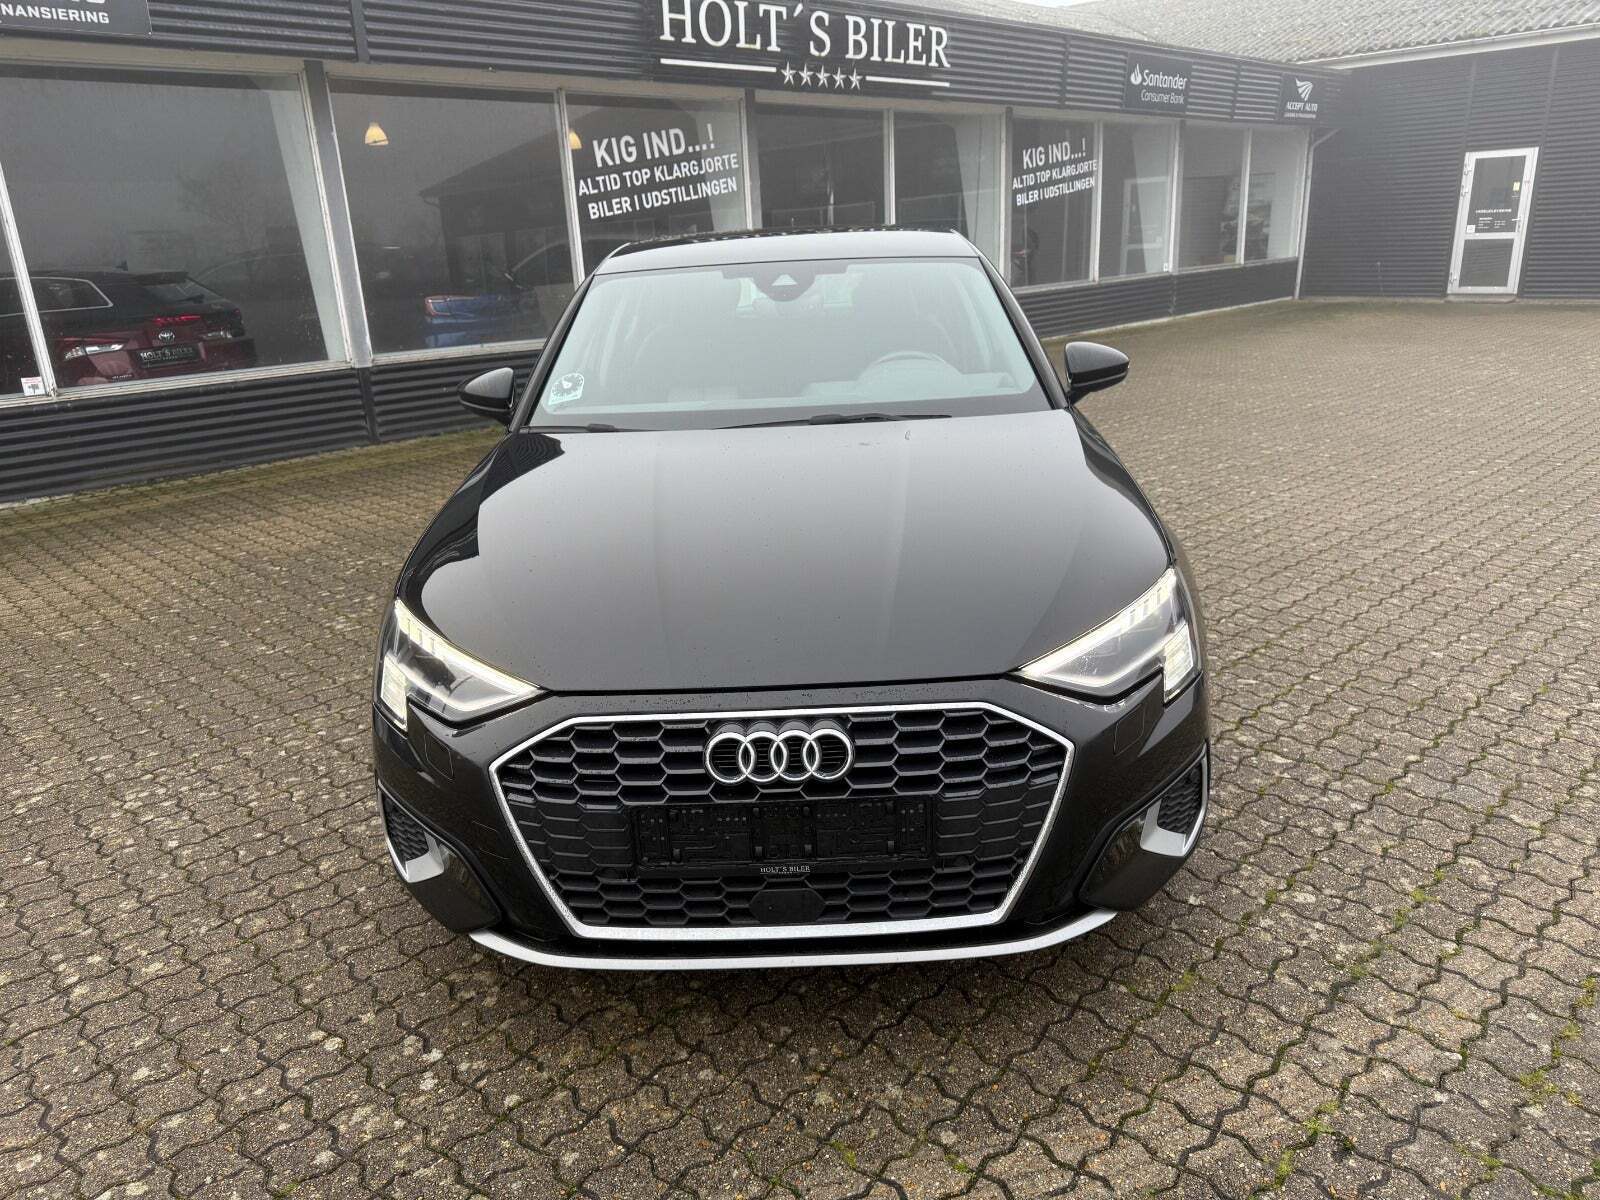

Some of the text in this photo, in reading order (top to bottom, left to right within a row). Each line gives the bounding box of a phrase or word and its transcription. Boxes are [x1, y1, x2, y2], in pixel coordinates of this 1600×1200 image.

[845, 15, 951, 68] BILER
[1142, 69, 1188, 89] Santander
[1141, 89, 1185, 104] Consumer Bank
[592, 135, 638, 168] KIG
[1022, 145, 1046, 170] KIG
[578, 153, 739, 196] ALTID TOP KLARGJORTE
[1012, 159, 1098, 190] ALTID TOP KLARGJORTE
[588, 176, 738, 220] BILER I UDSTILLINGEN
[1016, 176, 1095, 206] BILER I UDSTILLINGEN
[790, 865, 810, 873] BILER
